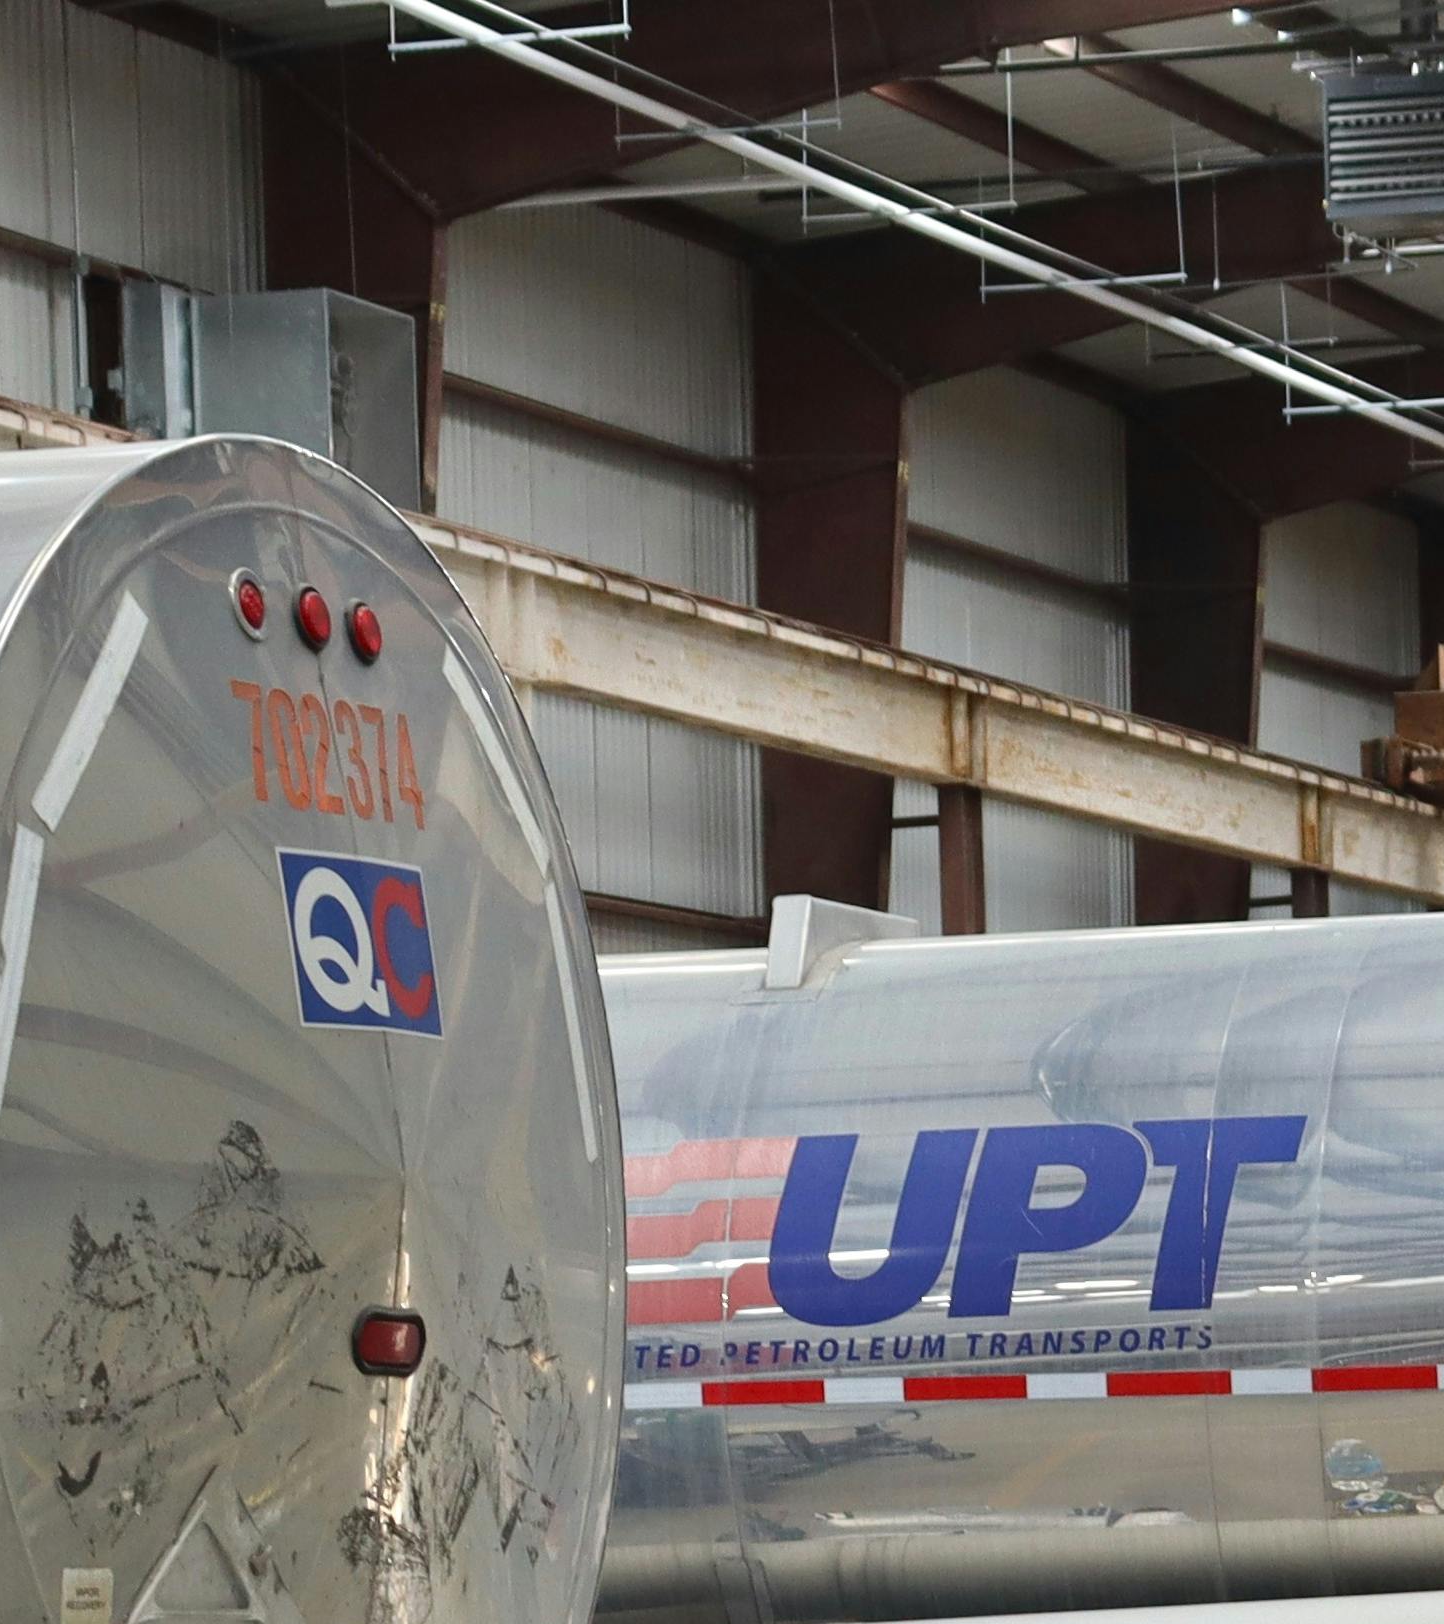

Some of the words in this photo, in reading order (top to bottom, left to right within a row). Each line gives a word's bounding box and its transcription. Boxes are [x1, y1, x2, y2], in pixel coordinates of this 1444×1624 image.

[229, 680, 426, 831] 702374
[294, 866, 433, 1020] QC
[767, 1115, 1308, 1327] UPT
[635, 1342, 703, 1370] TED
[718, 1334, 946, 1368] PETROLEUM
[966, 1325, 1214, 1358] TRANSPORTS
